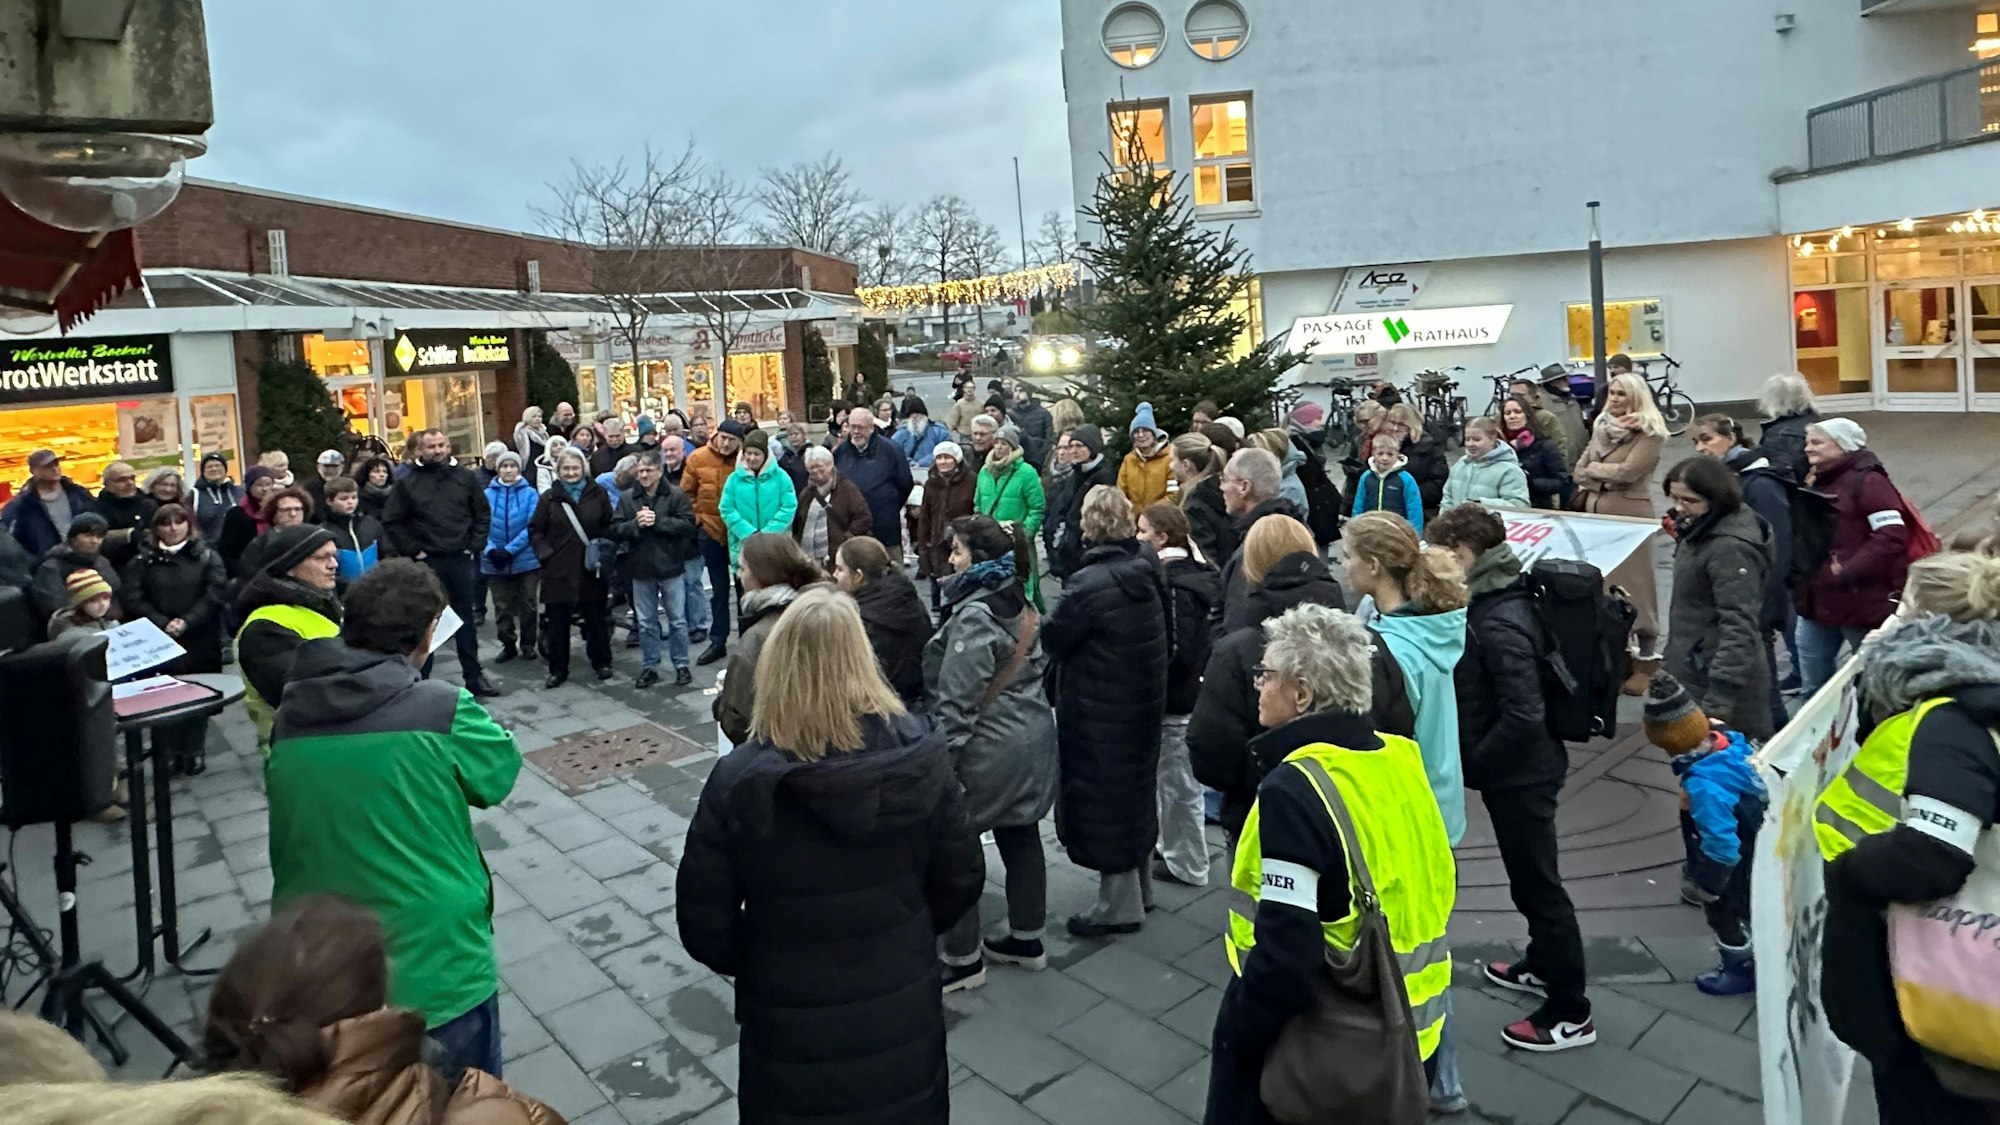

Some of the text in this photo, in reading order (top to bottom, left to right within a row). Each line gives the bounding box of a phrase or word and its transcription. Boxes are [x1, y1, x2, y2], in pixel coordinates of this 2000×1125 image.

[1303, 319, 1374, 334] PASSAGE
[1346, 327, 1489, 346] IM RATHAUS
[732, 328, 783, 349] potheke
[0, 359, 159, 390] rotWerkstatt
